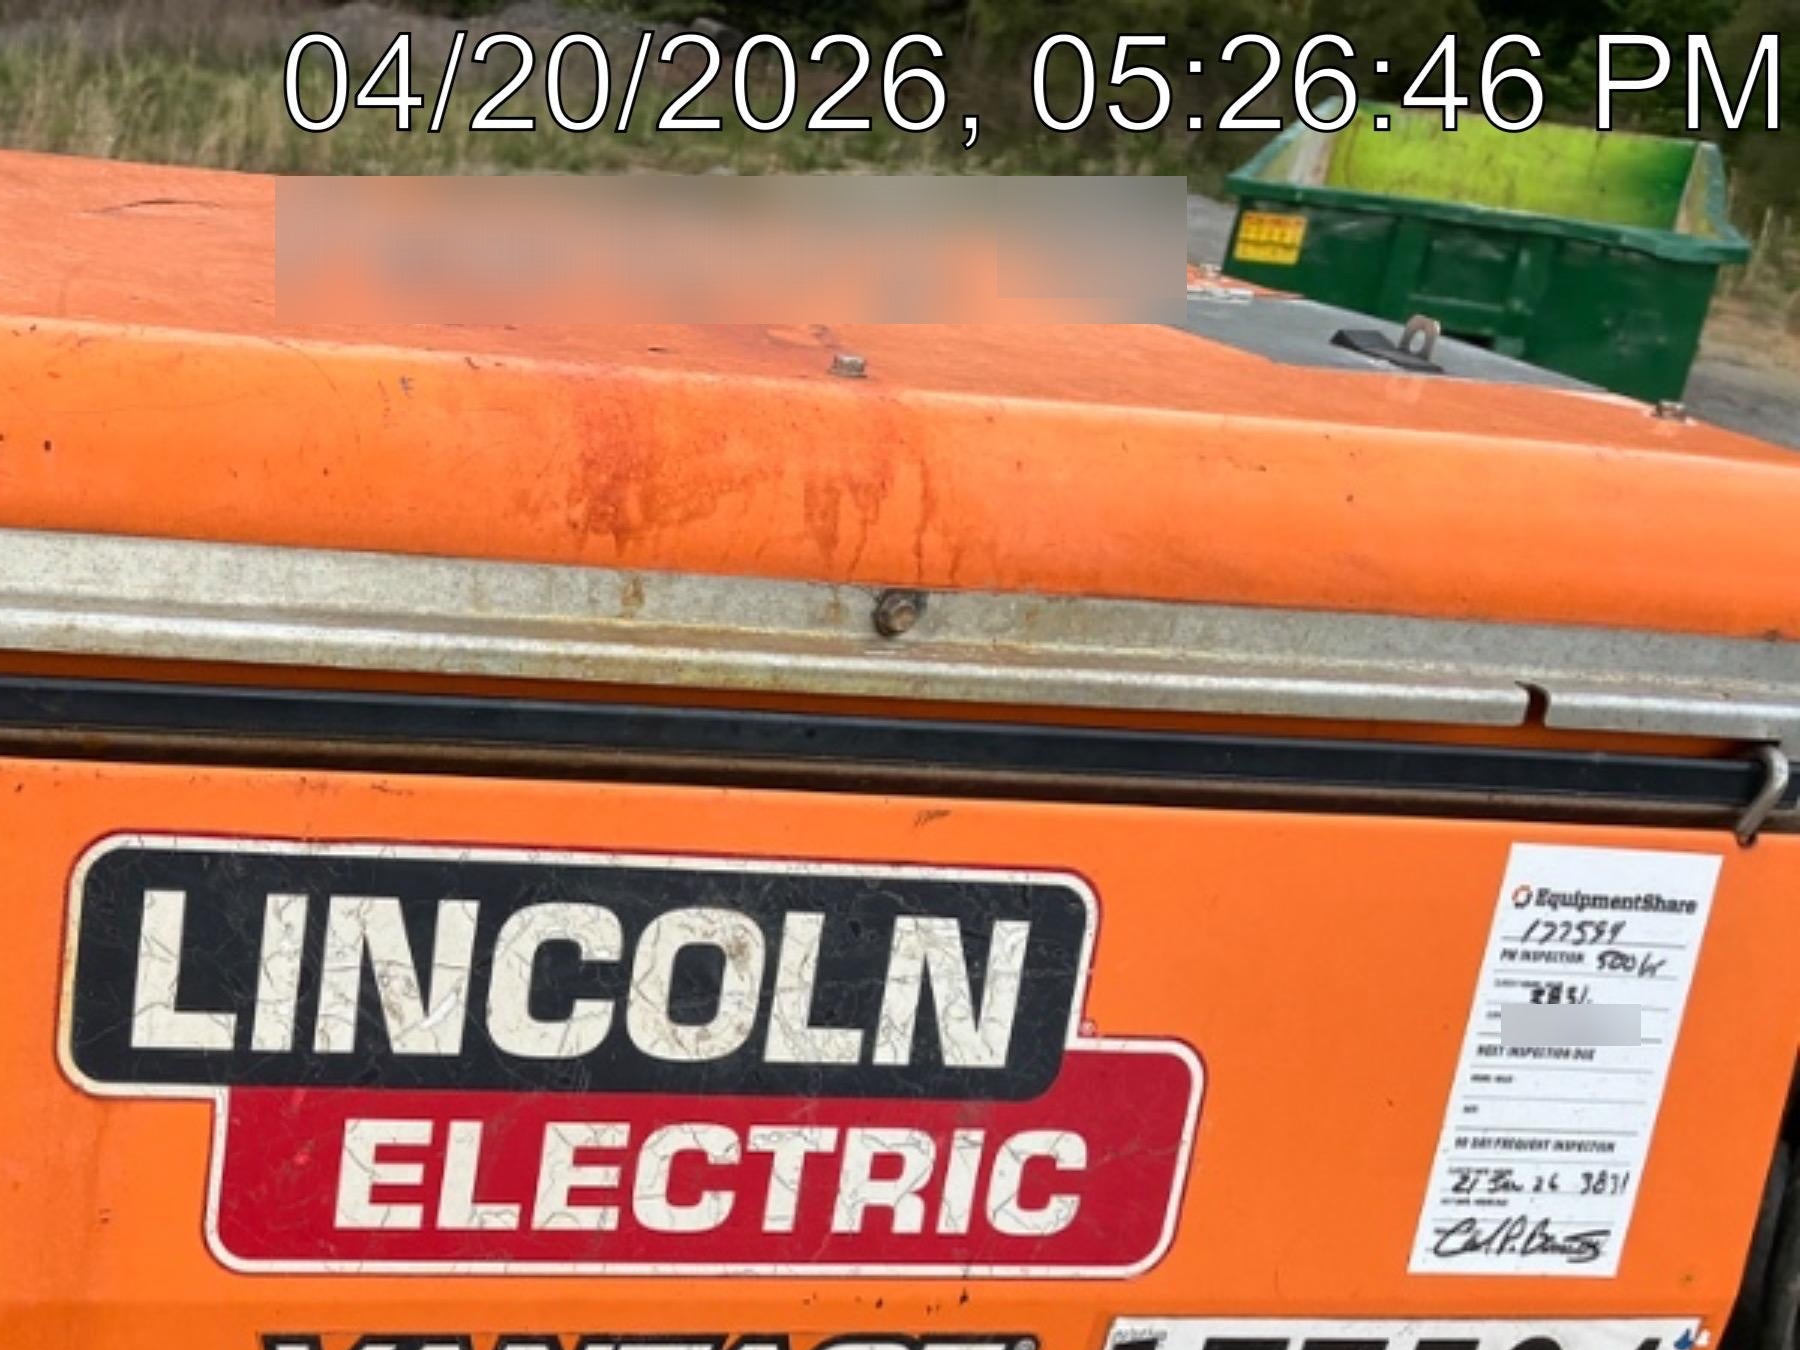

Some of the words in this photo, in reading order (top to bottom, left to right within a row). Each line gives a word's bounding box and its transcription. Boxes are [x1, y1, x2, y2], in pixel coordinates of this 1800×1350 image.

[1535, 887, 1698, 914] EquipmentShare
[1520, 950, 1585, 964] INSPECTION
[129, 888, 1031, 1068] LINCOLN
[1477, 1044, 1504, 1057] NEXT
[1506, 1046, 1571, 1060] INSPECTION
[1572, 1049, 1597, 1061] DUE
[1470, 1137, 1493, 1149] DAY
[1493, 1137, 1551, 1151] FREQUENT
[1552, 1140, 1616, 1153] INSPECTION
[333, 1118, 1088, 1238] ELECTRIC
